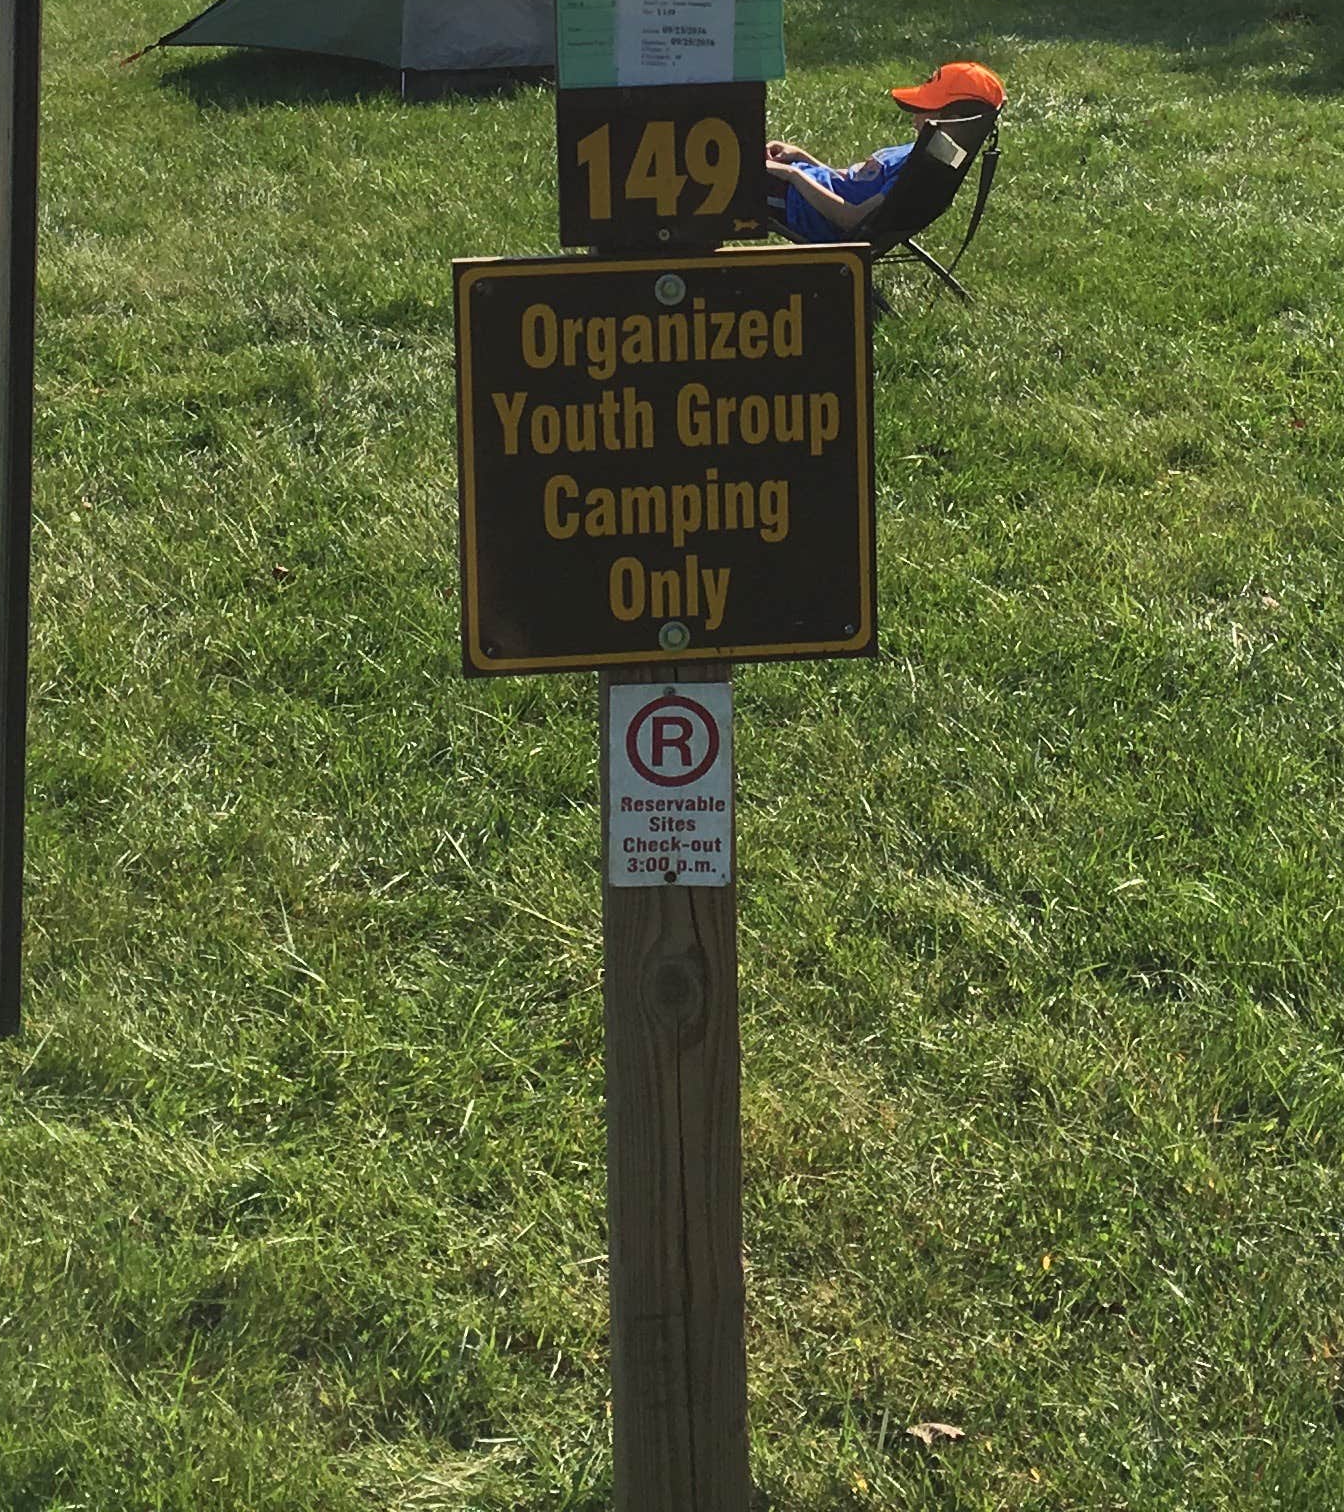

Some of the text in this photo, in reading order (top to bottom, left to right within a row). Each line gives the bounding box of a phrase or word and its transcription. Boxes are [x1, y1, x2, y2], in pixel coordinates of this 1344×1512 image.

[576, 116, 741, 220] 149
[521, 294, 803, 380] Organized
[492, 383, 840, 456] Youth Group
[543, 468, 789, 548] Camping
[609, 554, 730, 630] Only
[651, 716, 694, 767] R
[620, 796, 726, 813] Reservable
[649, 816, 696, 832] Sites
[623, 837, 722, 853] Check-out
[627, 857, 717, 875] 3:00 p.m.
